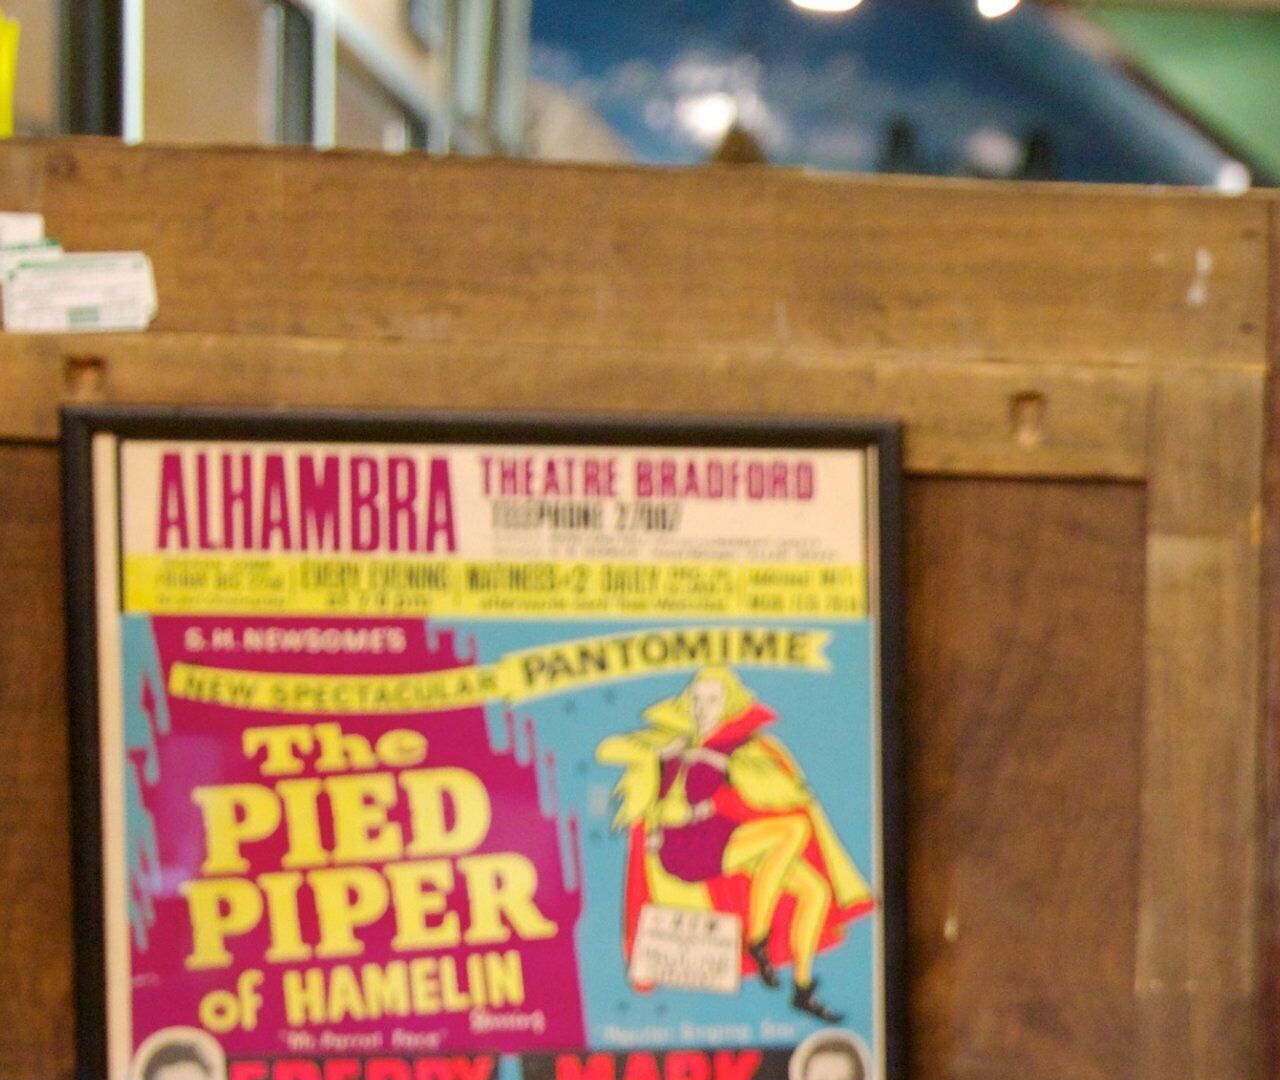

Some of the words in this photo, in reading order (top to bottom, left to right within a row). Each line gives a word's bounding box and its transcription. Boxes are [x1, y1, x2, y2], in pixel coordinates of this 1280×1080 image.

[158, 453, 456, 551] ALHAMBRA
[480, 457, 617, 497] THEATRE
[635, 459, 815, 501] BRADFORD
[521, 630, 811, 685] PANTOMIME
[241, 722, 428, 776] The
[191, 767, 493, 877] PIED
[182, 851, 559, 970] PIPER
[198, 968, 264, 1034] of
[282, 949, 526, 1028] HAMELIN
